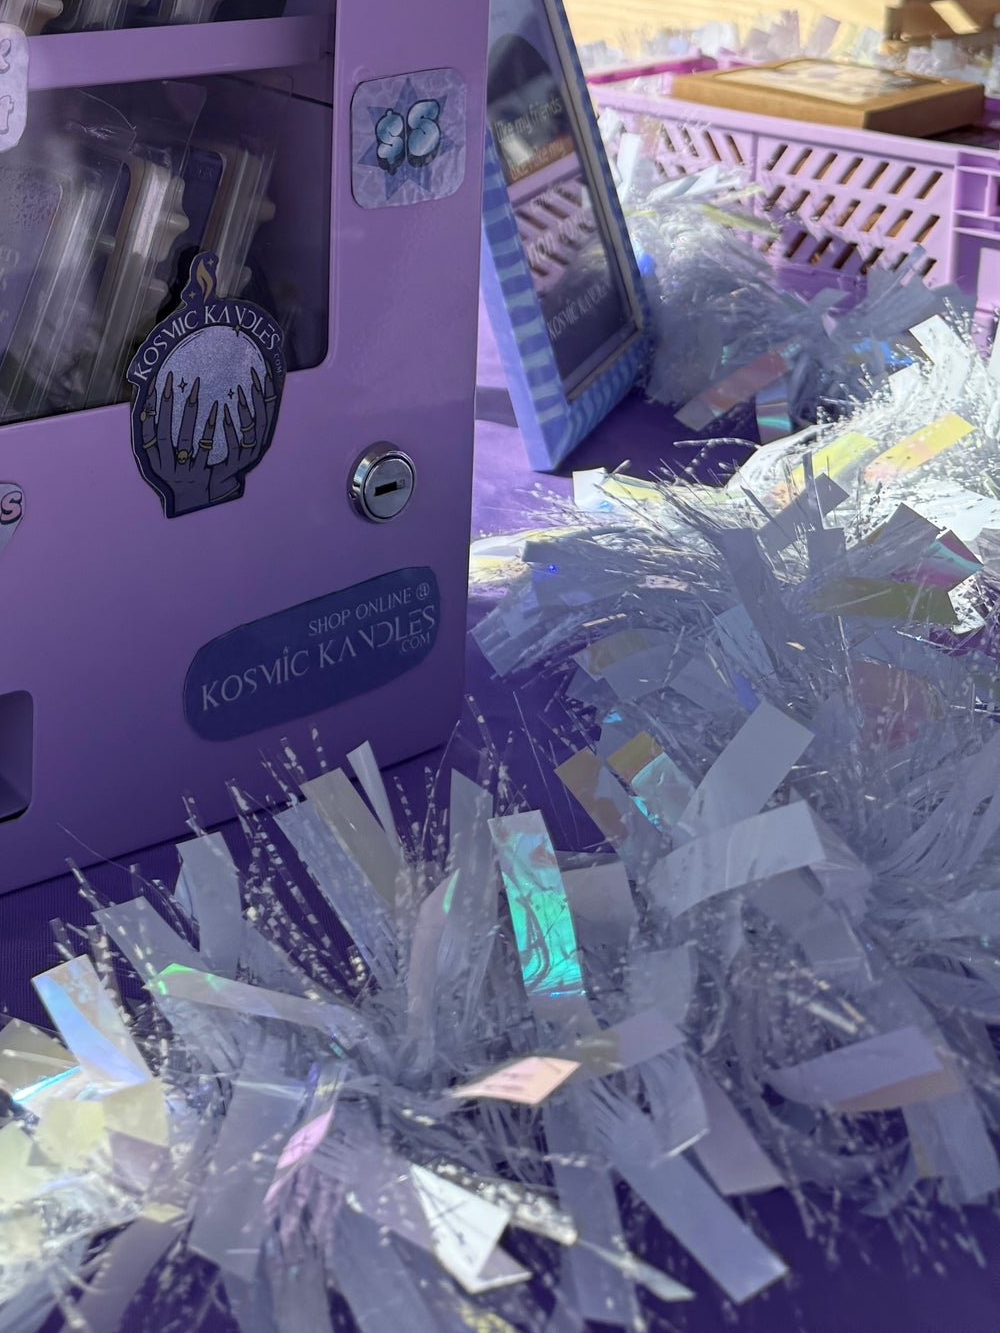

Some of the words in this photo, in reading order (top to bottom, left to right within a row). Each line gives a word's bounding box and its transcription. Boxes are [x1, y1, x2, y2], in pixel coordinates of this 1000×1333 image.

[375, 98, 442, 175] $5
[134, 310, 199, 381] KOSMIC
[308, 608, 351, 637] SHOP
[355, 586, 412, 620] ONLINE
[416, 581, 431, 601] @
[201, 645, 310, 711] KOSMIC
